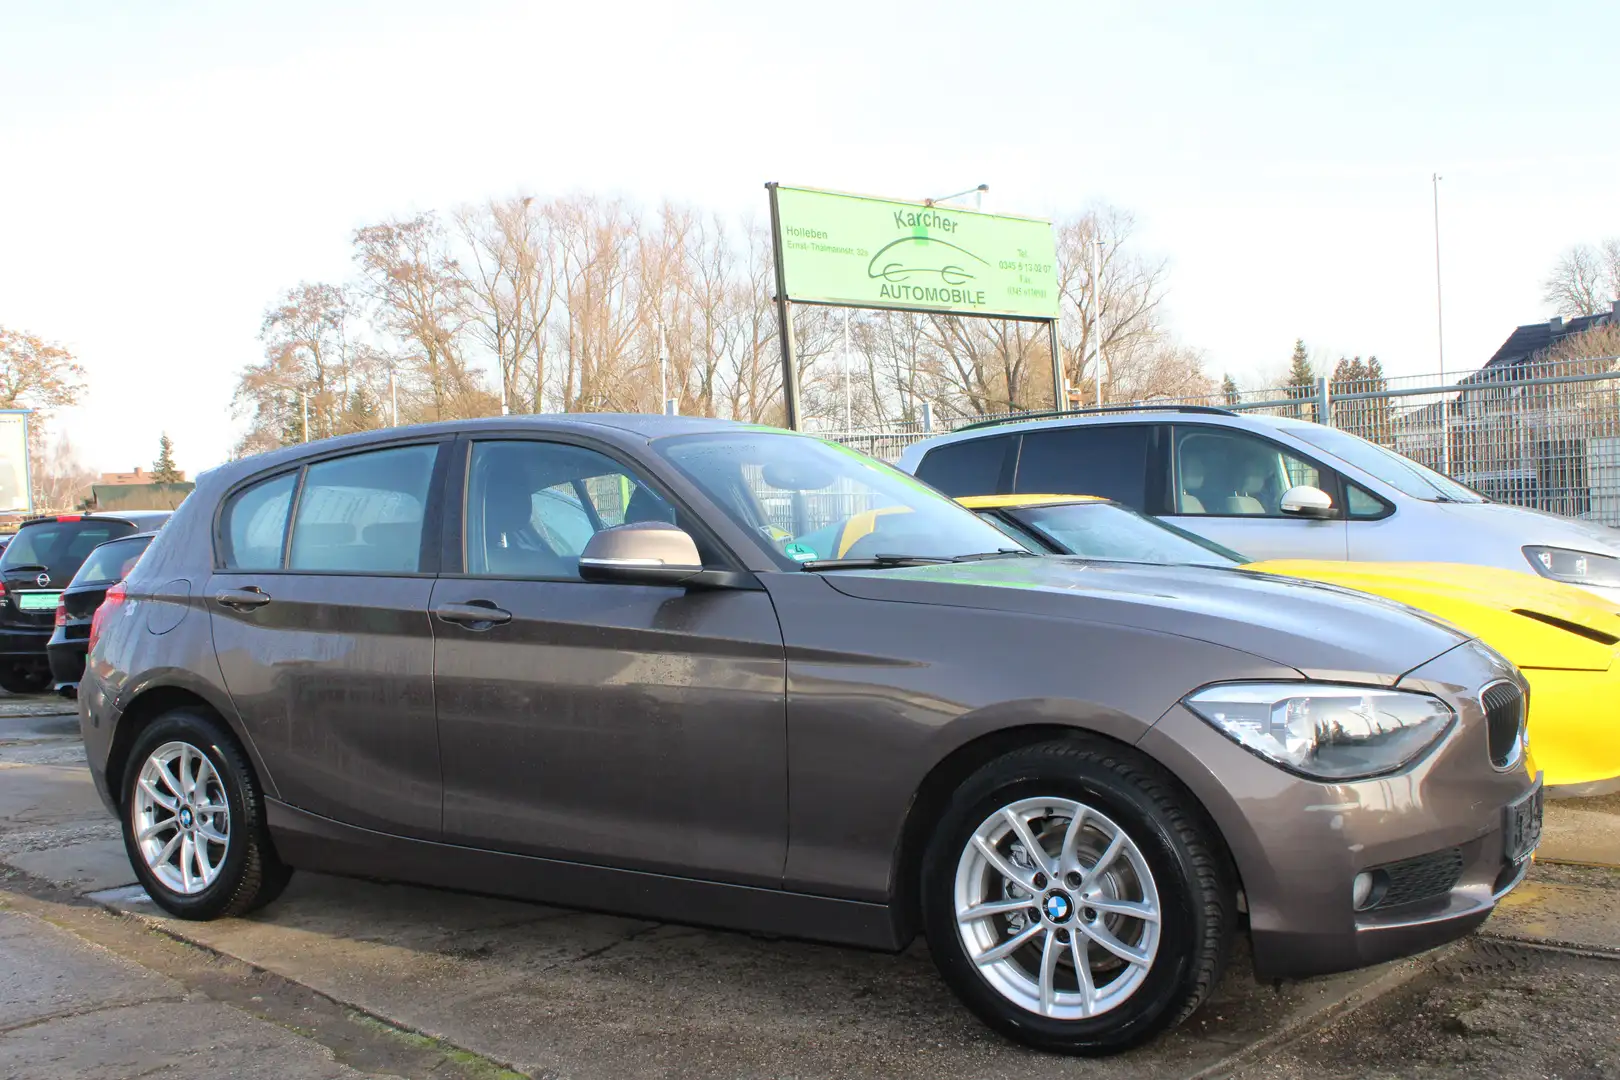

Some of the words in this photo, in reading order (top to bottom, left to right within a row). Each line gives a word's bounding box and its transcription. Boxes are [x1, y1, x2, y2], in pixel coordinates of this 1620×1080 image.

[893, 208, 959, 234] Karcher
[786, 225, 828, 240] Holleben
[998, 260, 1016, 271] 0345
[879, 283, 986, 305] AUTOMOBILE
